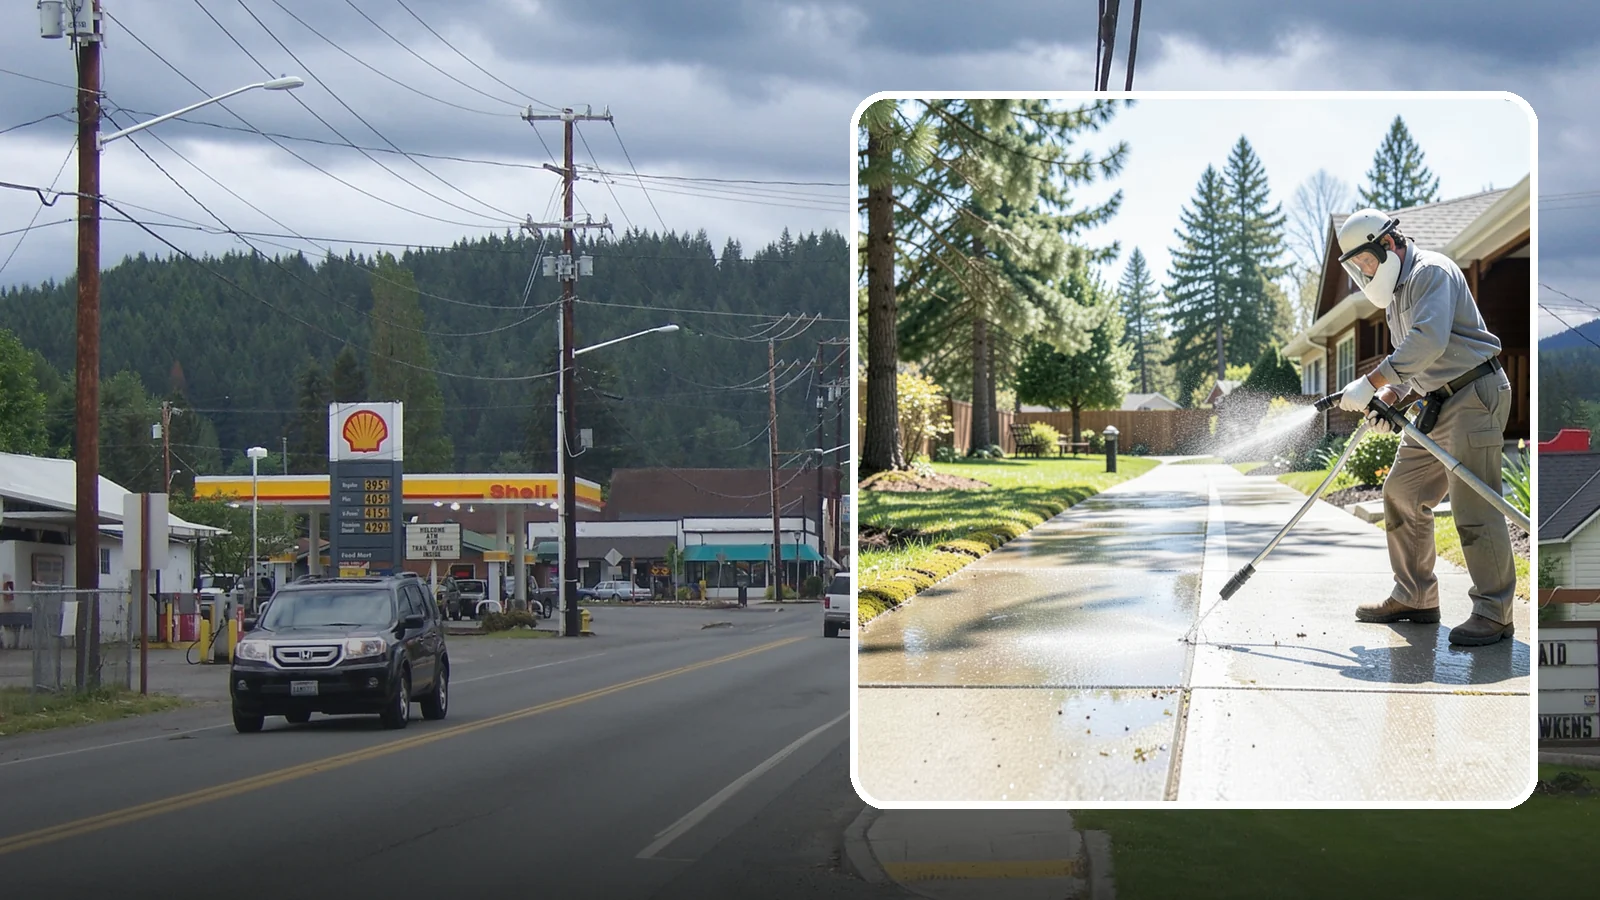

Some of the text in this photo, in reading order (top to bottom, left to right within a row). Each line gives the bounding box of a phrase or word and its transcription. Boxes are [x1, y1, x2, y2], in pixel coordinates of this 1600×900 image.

[366, 480, 383, 490] 395
[490, 484, 547, 499] Shell
[366, 494, 383, 504] 405
[366, 508, 383, 518] 415
[366, 522, 383, 532] 429
